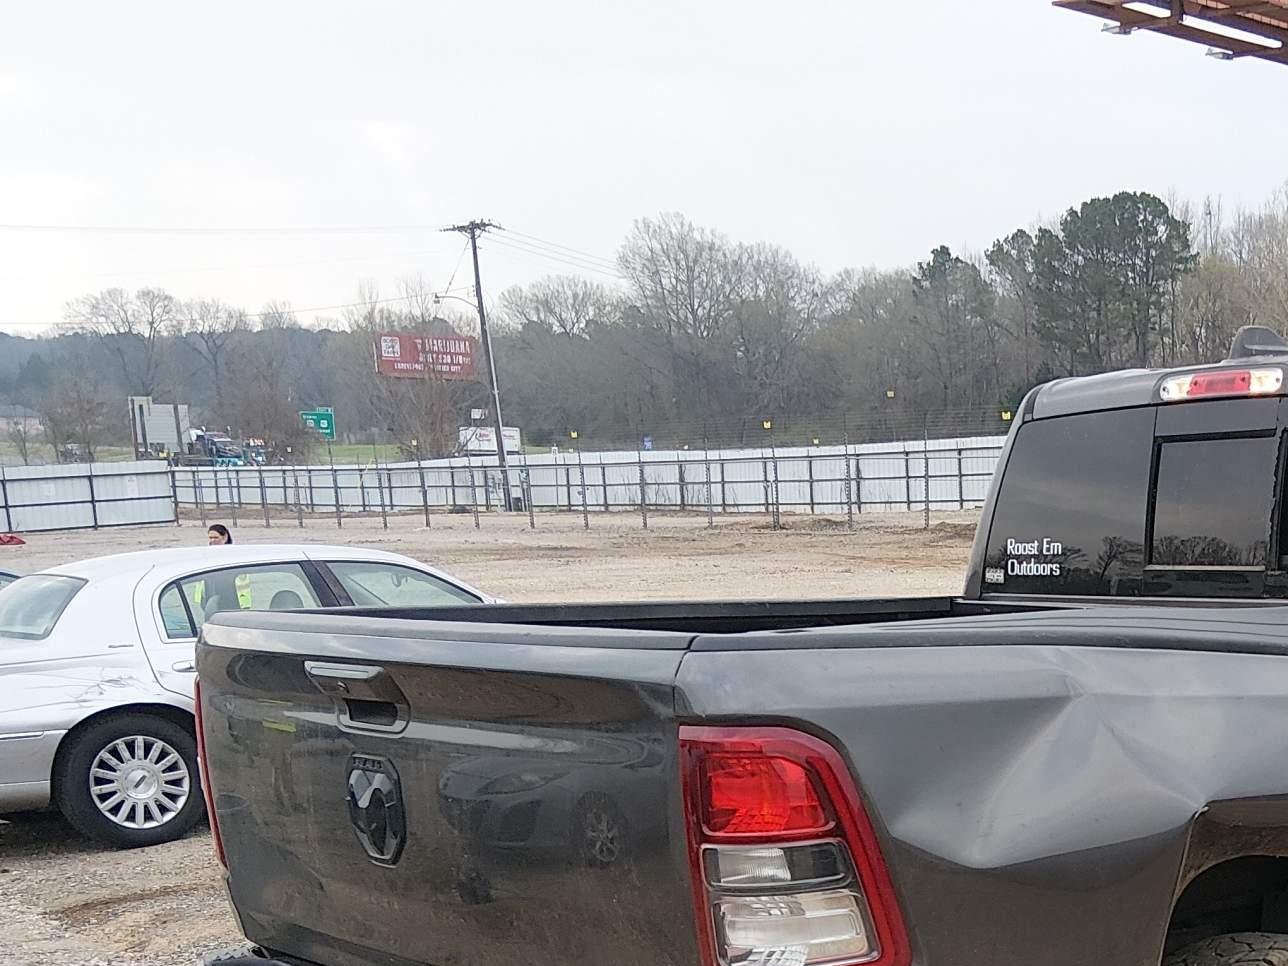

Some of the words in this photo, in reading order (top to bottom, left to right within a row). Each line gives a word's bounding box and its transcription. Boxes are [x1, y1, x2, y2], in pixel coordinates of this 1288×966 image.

[1007, 538, 1039, 555] Roost
[1043, 537, 1062, 555] Em
[1007, 557, 1060, 576] Outdoors
